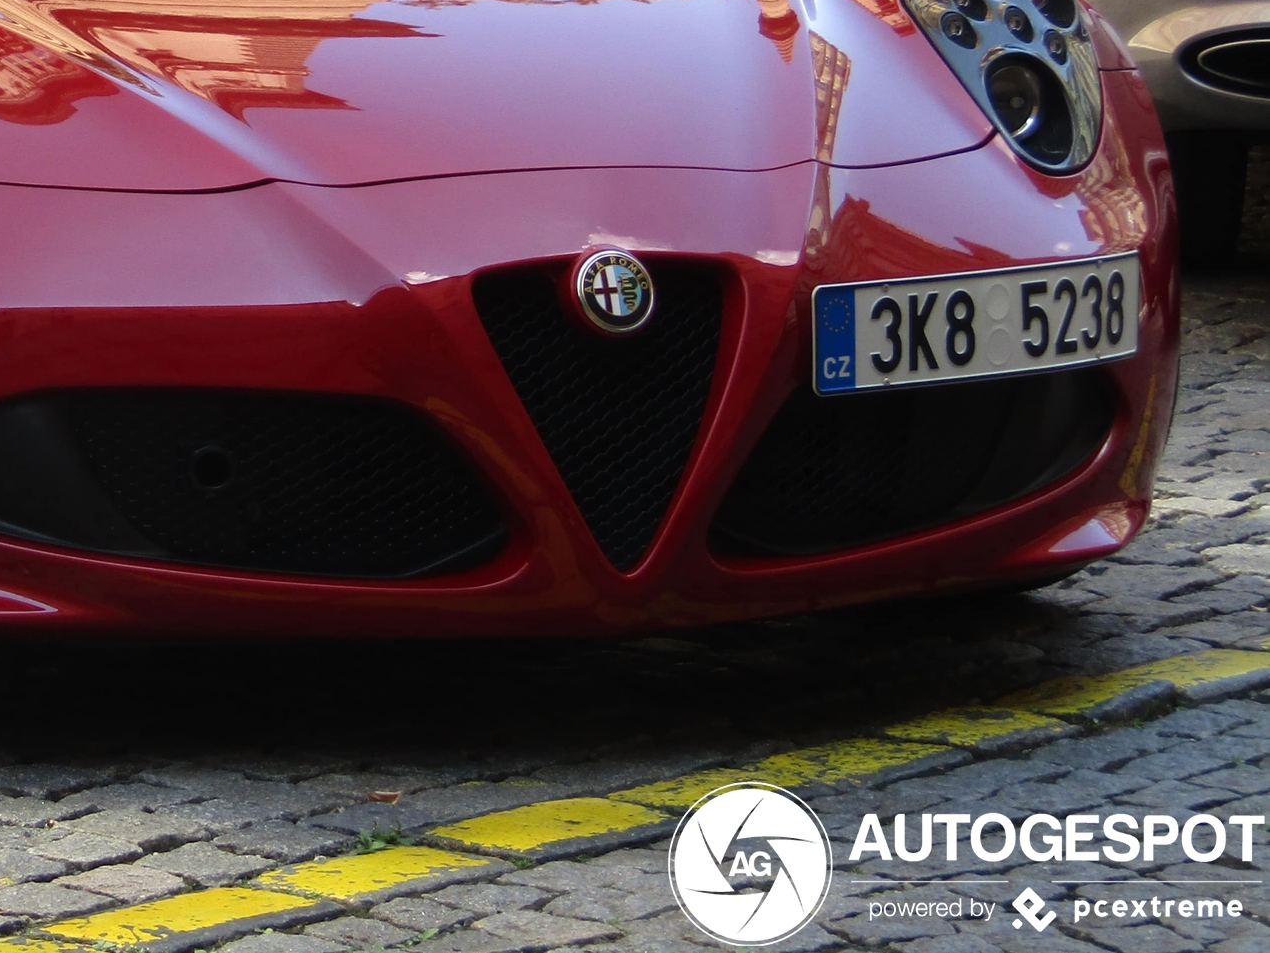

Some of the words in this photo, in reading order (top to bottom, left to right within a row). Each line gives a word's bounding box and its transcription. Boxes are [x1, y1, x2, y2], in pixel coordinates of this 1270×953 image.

[584, 261, 605, 293] ALFA
[610, 257, 648, 290] ROMEO
[870, 288, 975, 373] 3K8
[1020, 269, 1124, 357] 5238
[823, 355, 851, 379] CZ
